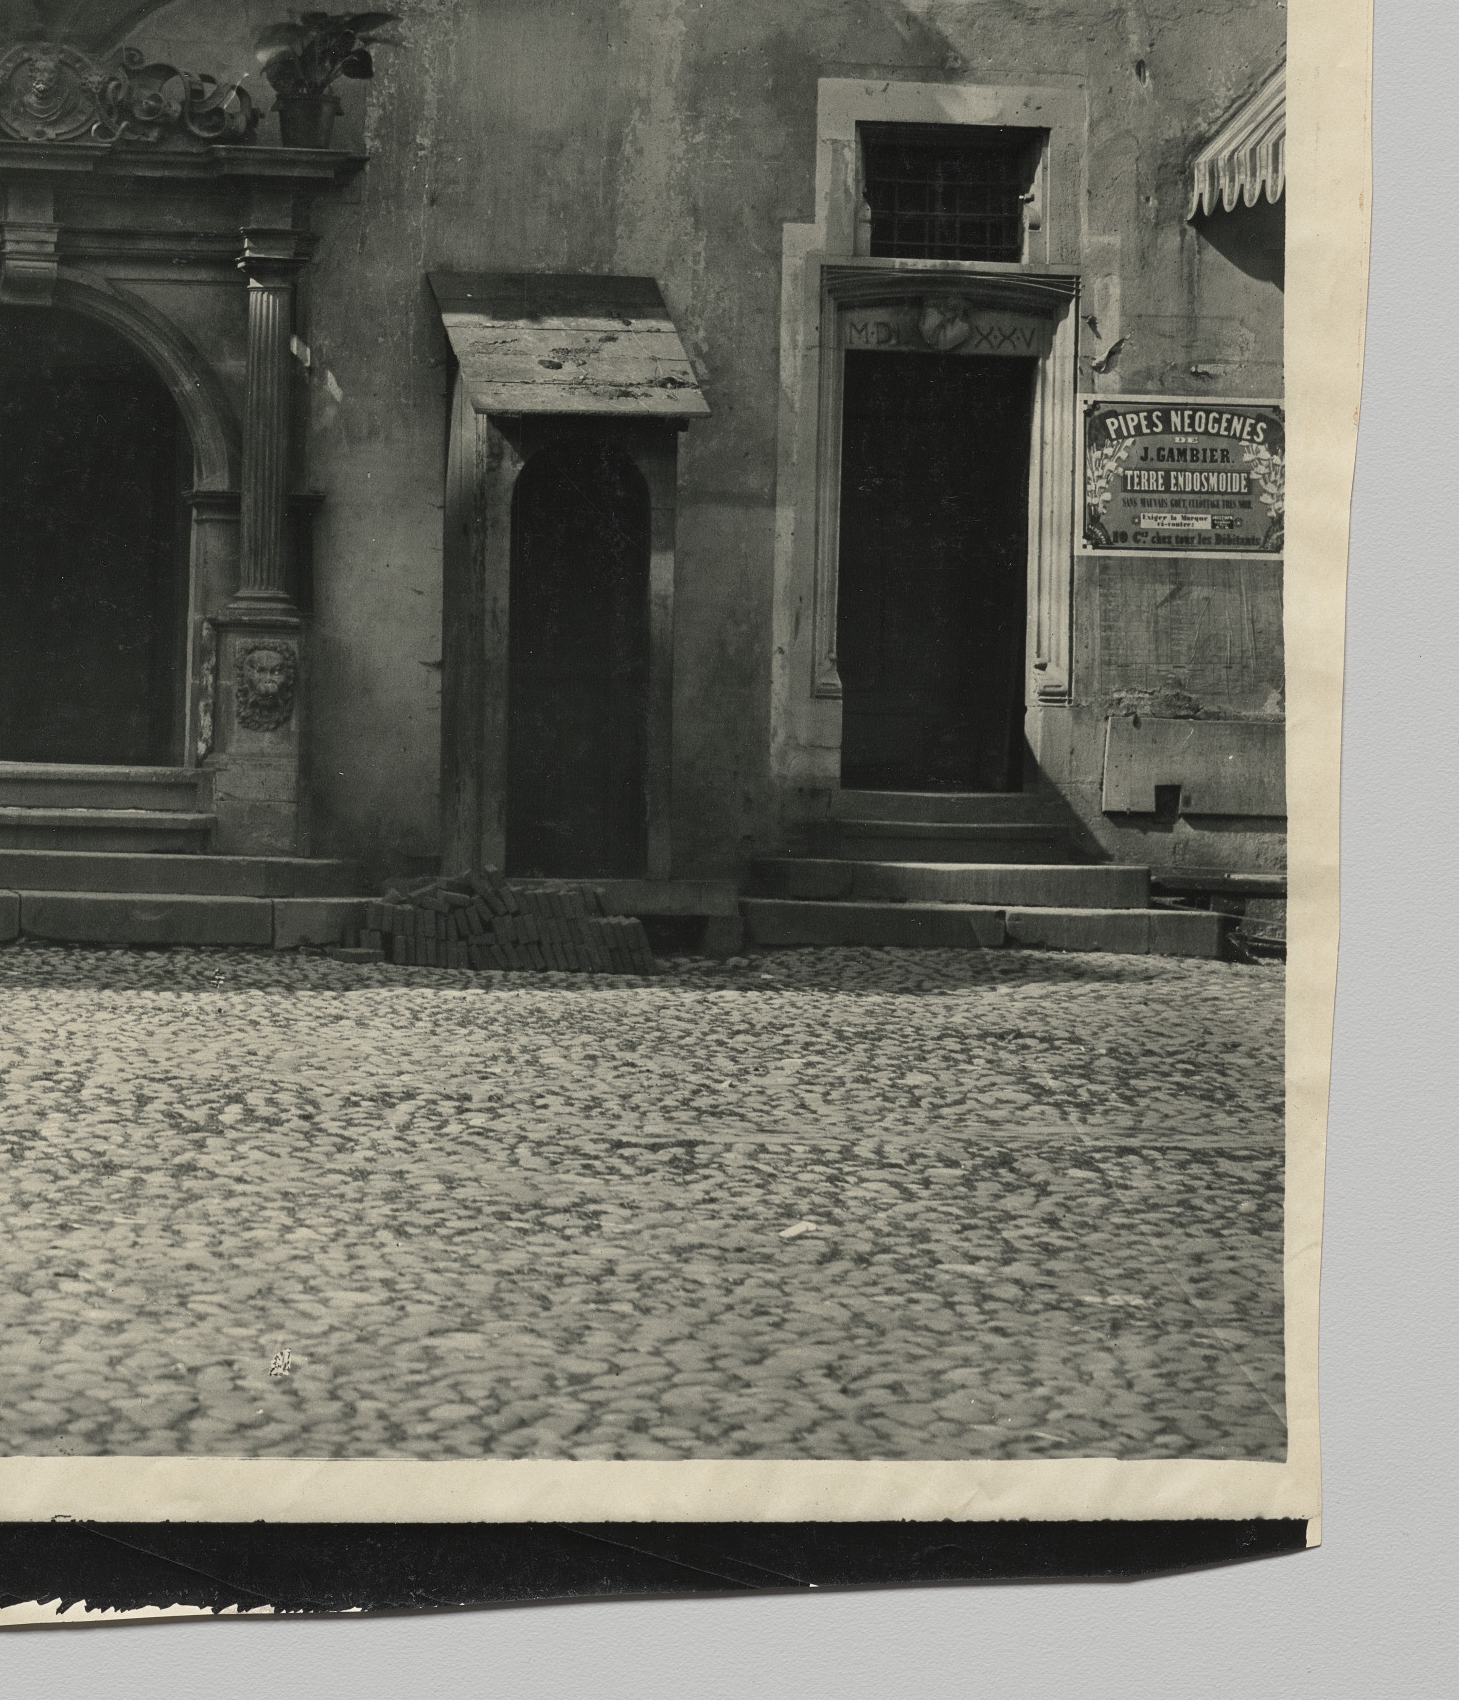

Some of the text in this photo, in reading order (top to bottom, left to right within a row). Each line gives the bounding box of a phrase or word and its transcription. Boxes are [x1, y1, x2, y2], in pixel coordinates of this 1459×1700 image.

[1105, 410, 1267, 442] PIPES NEOGENES
[1174, 436, 1199, 444] DE
[1124, 470, 1248, 493] TERRE ENDOSMOIDE
[1122, 497, 1138, 508] SANS
[1142, 513, 1167, 522] Exiger
[1181, 514, 1209, 522] Marque
[1113, 530, 1128, 544] 10
[1151, 531, 1172, 545] chez
[1197, 533, 1212, 545] les
